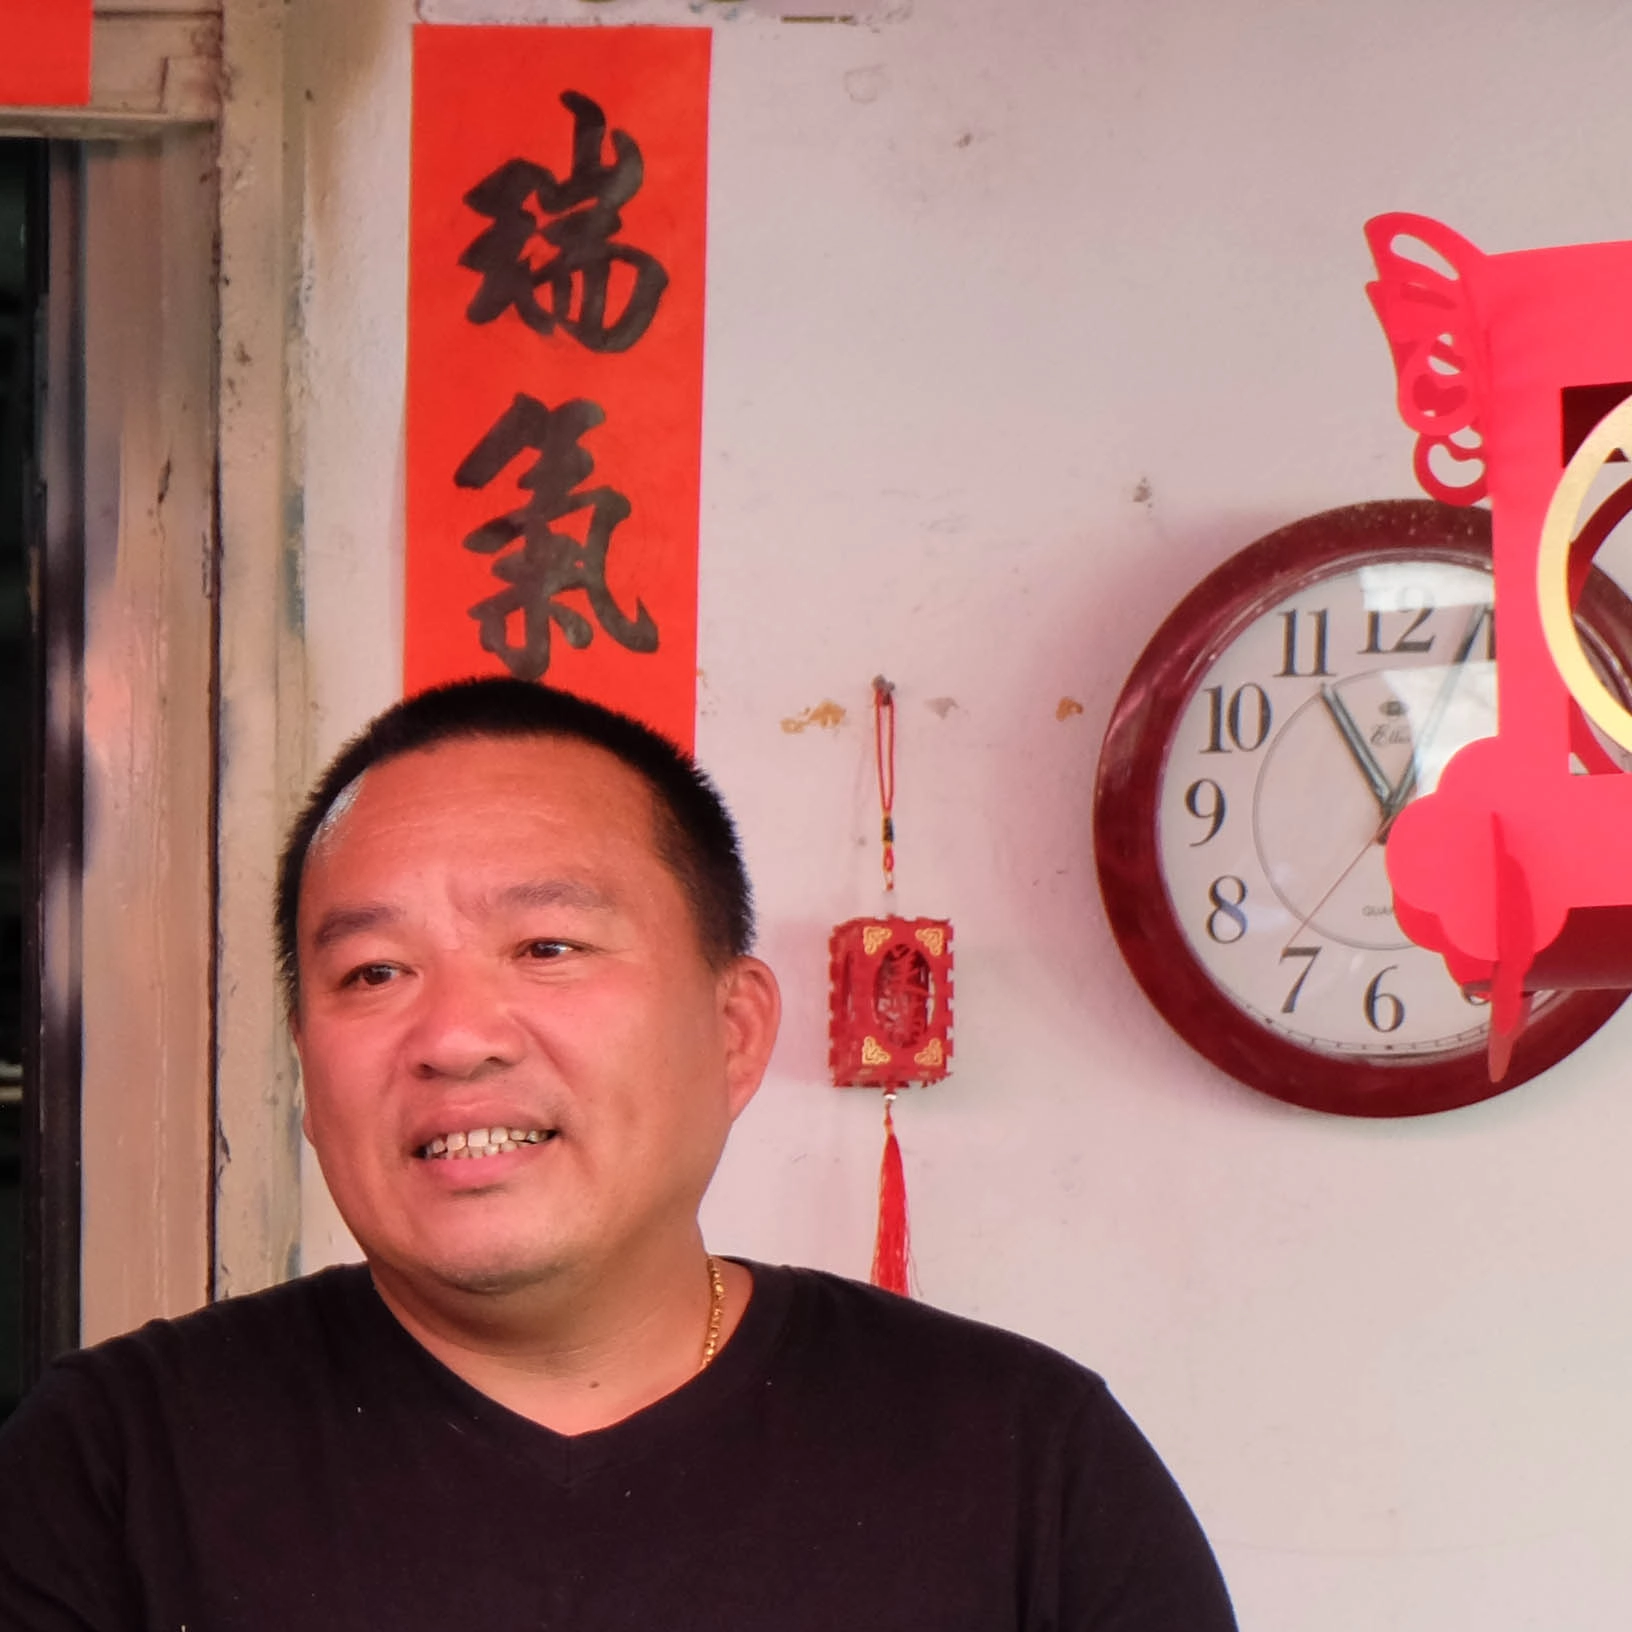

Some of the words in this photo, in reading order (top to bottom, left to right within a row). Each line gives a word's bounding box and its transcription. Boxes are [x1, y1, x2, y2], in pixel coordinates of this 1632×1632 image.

[453, 90, 669, 681] 瑞氣
[1273, 608, 1336, 678] 11
[1357, 586, 1436, 655] 12
[1199, 682, 1272, 754] 10
[1184, 778, 1227, 848] 9
[1206, 875, 1248, 945] 8
[1279, 946, 1322, 1014] 7
[1363, 965, 1405, 1033] 6
